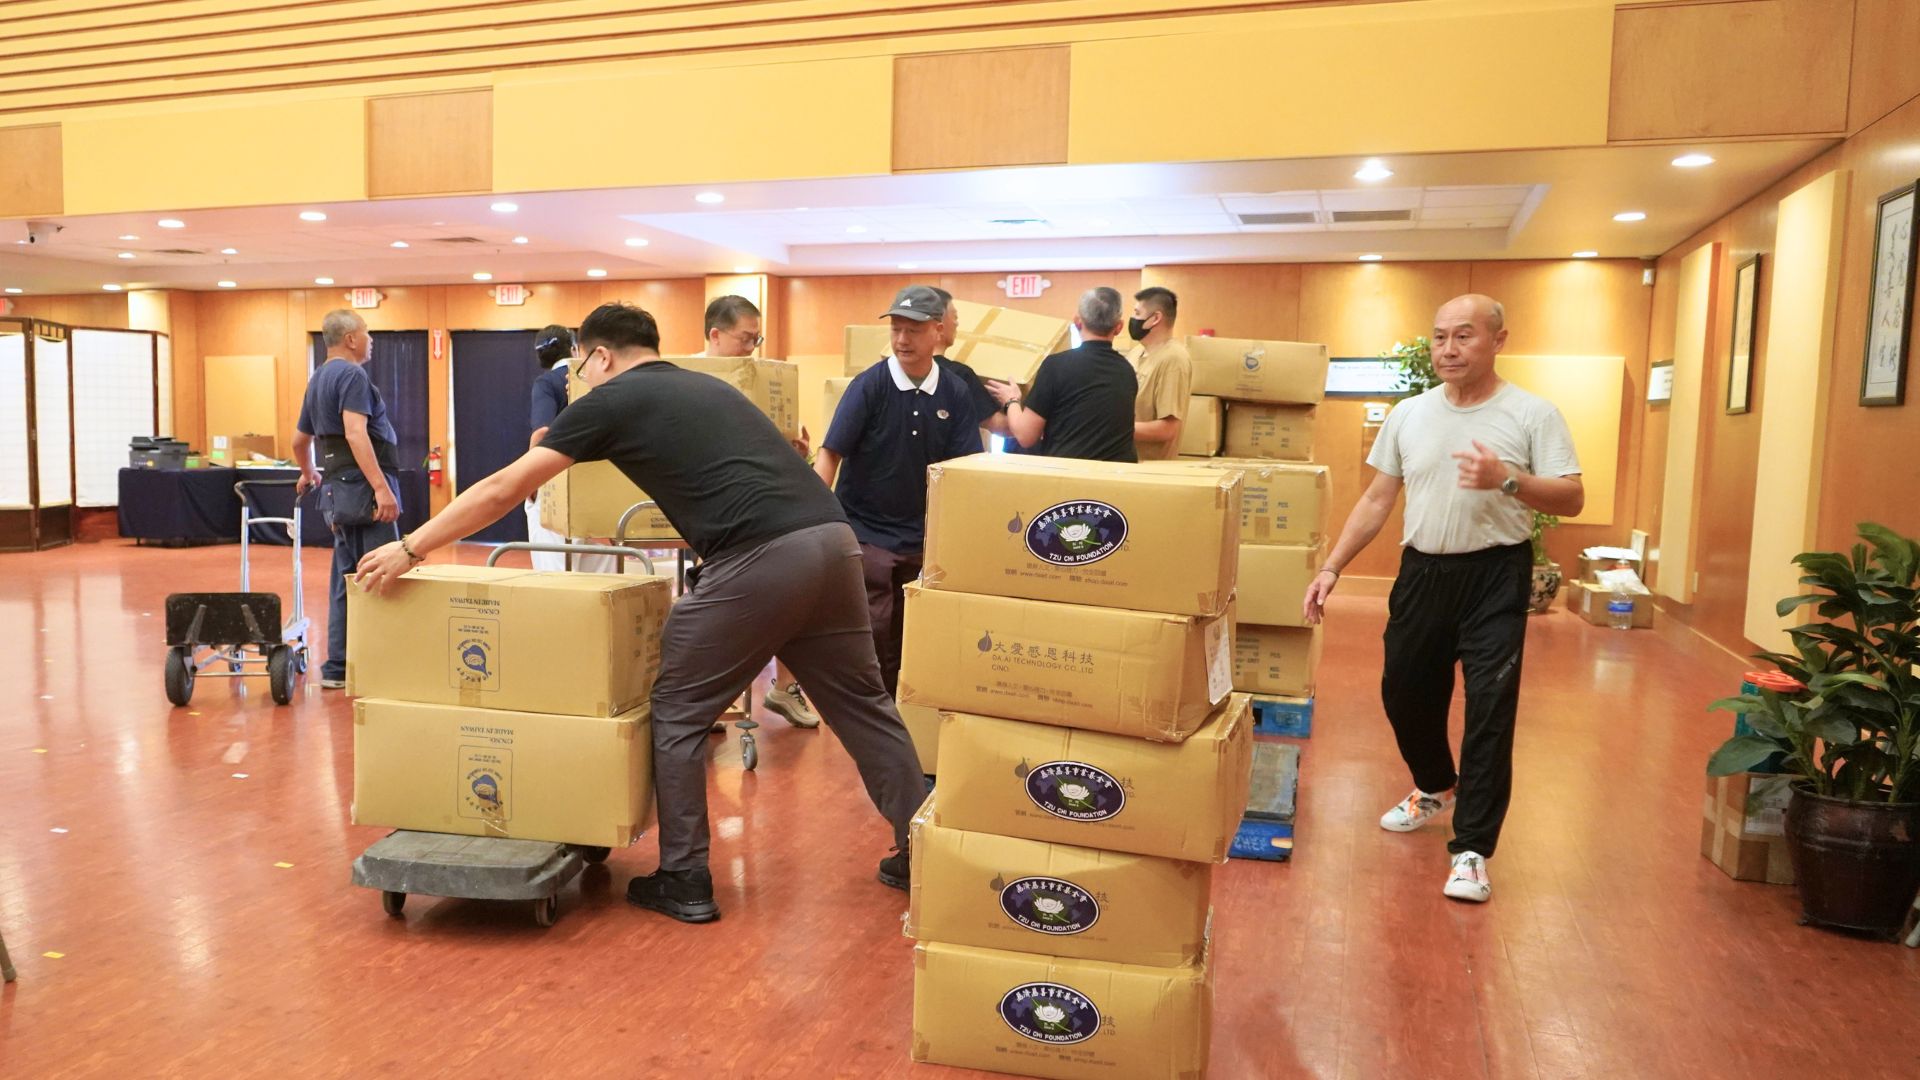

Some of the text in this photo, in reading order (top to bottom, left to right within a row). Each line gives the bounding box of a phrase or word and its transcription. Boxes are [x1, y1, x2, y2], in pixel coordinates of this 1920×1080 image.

[500, 286, 519, 303] EXIT
[1012, 276, 1037, 295] EXIT
[355, 288, 373, 306] EXIT
[1049, 553, 1062, 561] TZU
[1076, 541, 1114, 561] FOUNDATION
[993, 641, 1095, 666] 大愛感恩科技
[1013, 658, 1061, 670] TECHNOLOGY
[1044, 801, 1055, 811] TZU
[1057, 807, 1067, 815] CHI
[1069, 809, 1107, 819] FOUNDATION
[1018, 914, 1029, 924] TZU
[1031, 921, 1041, 929] CHI
[1043, 922, 1081, 932] FOUNDATION
[1019, 1024, 1031, 1034] TZU
[1045, 1031, 1083, 1041] FOUNDATION
